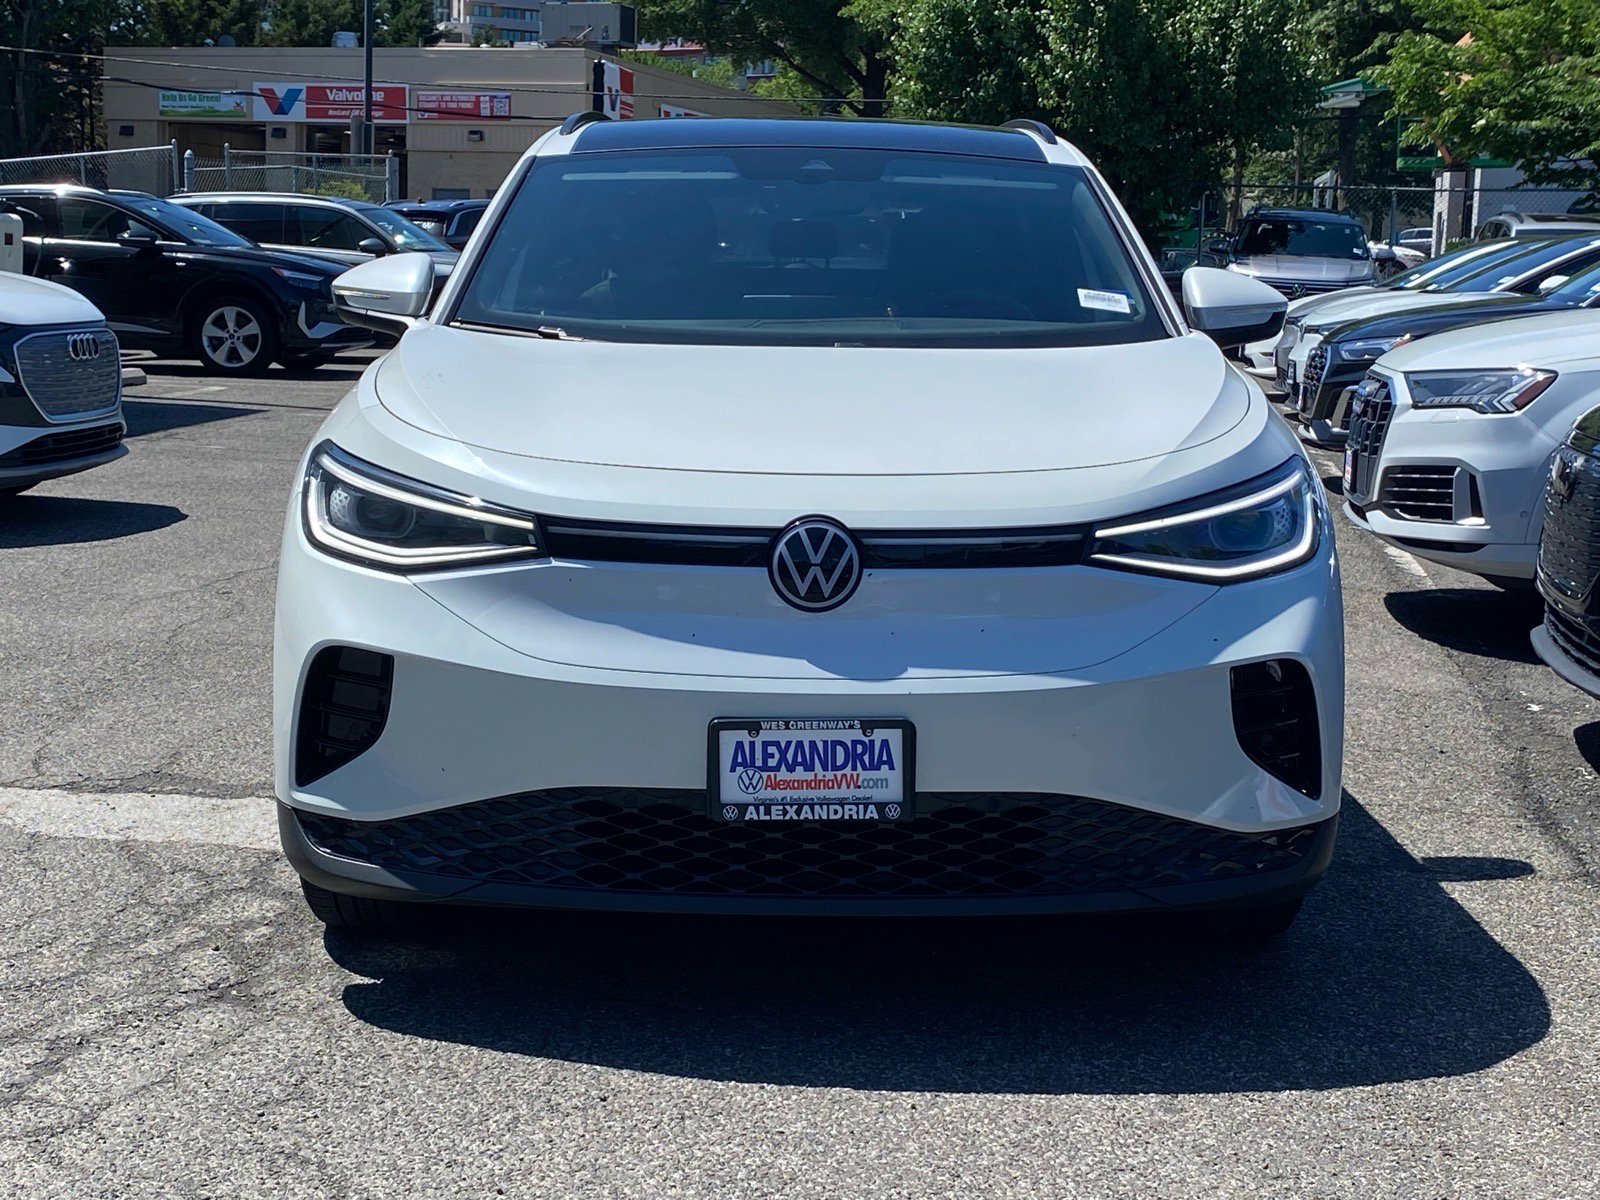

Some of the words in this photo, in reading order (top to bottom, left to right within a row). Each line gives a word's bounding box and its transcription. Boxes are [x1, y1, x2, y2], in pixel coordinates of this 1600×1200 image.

[161, 93, 177, 102] Help
[188, 94, 197, 102] Go
[326, 88, 385, 101] Valvolne
[761, 721, 785, 730] WES
[789, 720, 861, 730] GREENWAY'S
[729, 739, 896, 773] ALEXANDRIA
[764, 772, 889, 791] AlexandriaVW.com
[744, 804, 879, 820] ALEXANDRIA
